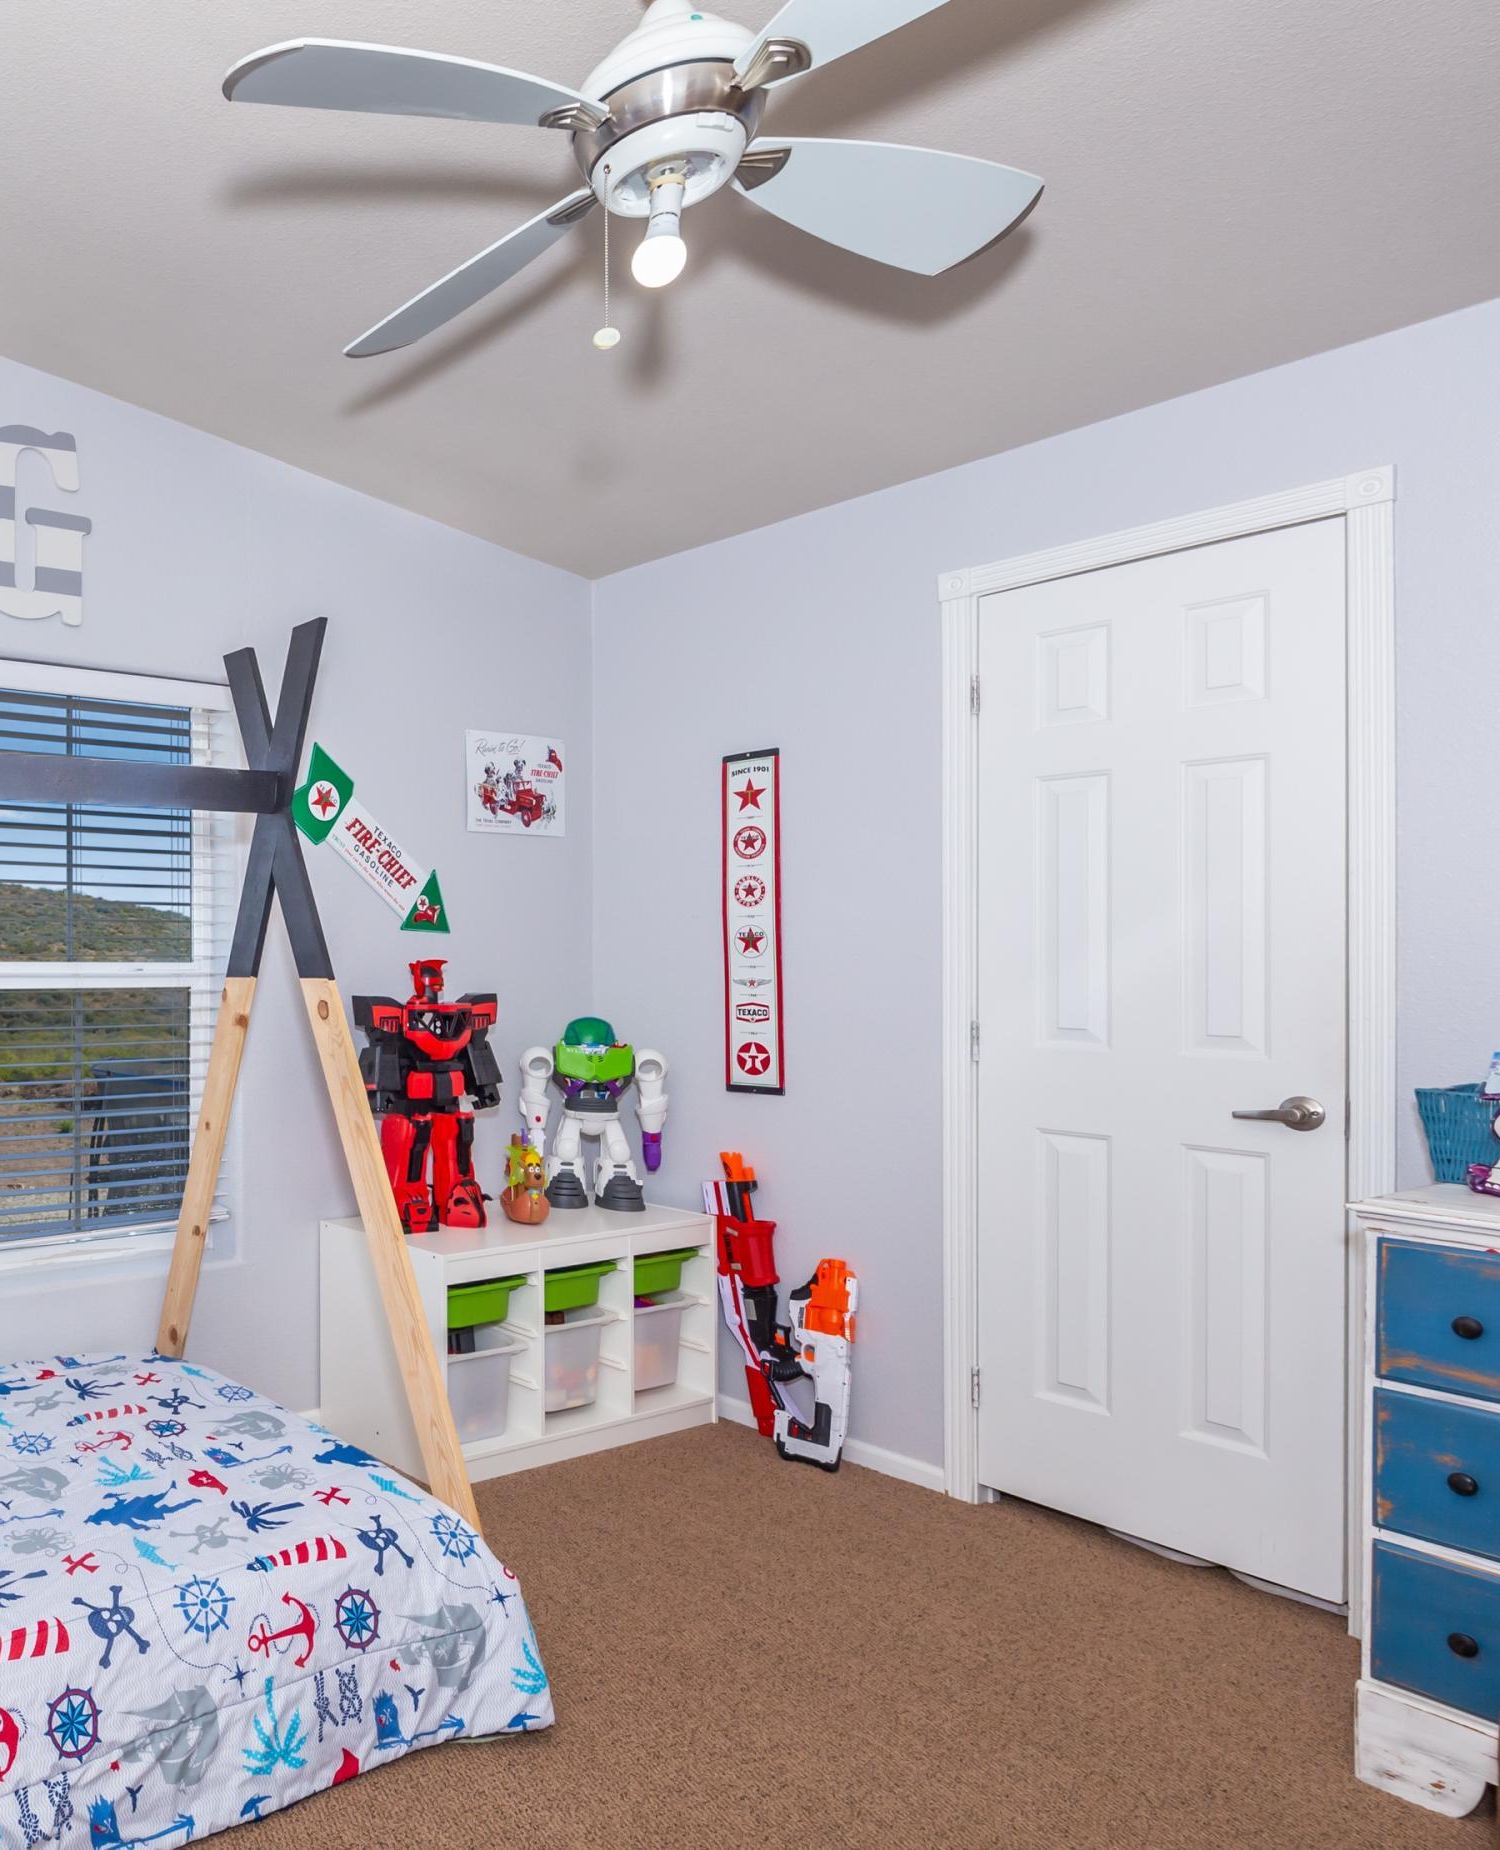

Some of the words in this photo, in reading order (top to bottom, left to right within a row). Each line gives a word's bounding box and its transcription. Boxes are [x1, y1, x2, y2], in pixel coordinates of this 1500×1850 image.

[731, 766, 751, 777] SINCE
[753, 765, 770, 774] 1901
[320, 784, 338, 804] TECO
[345, 818, 418, 891] FIRE-CHIEF
[374, 826, 402, 858] TEXACO
[353, 844, 394, 888] GASOLINE
[737, 1008, 768, 1017] TEXACO
